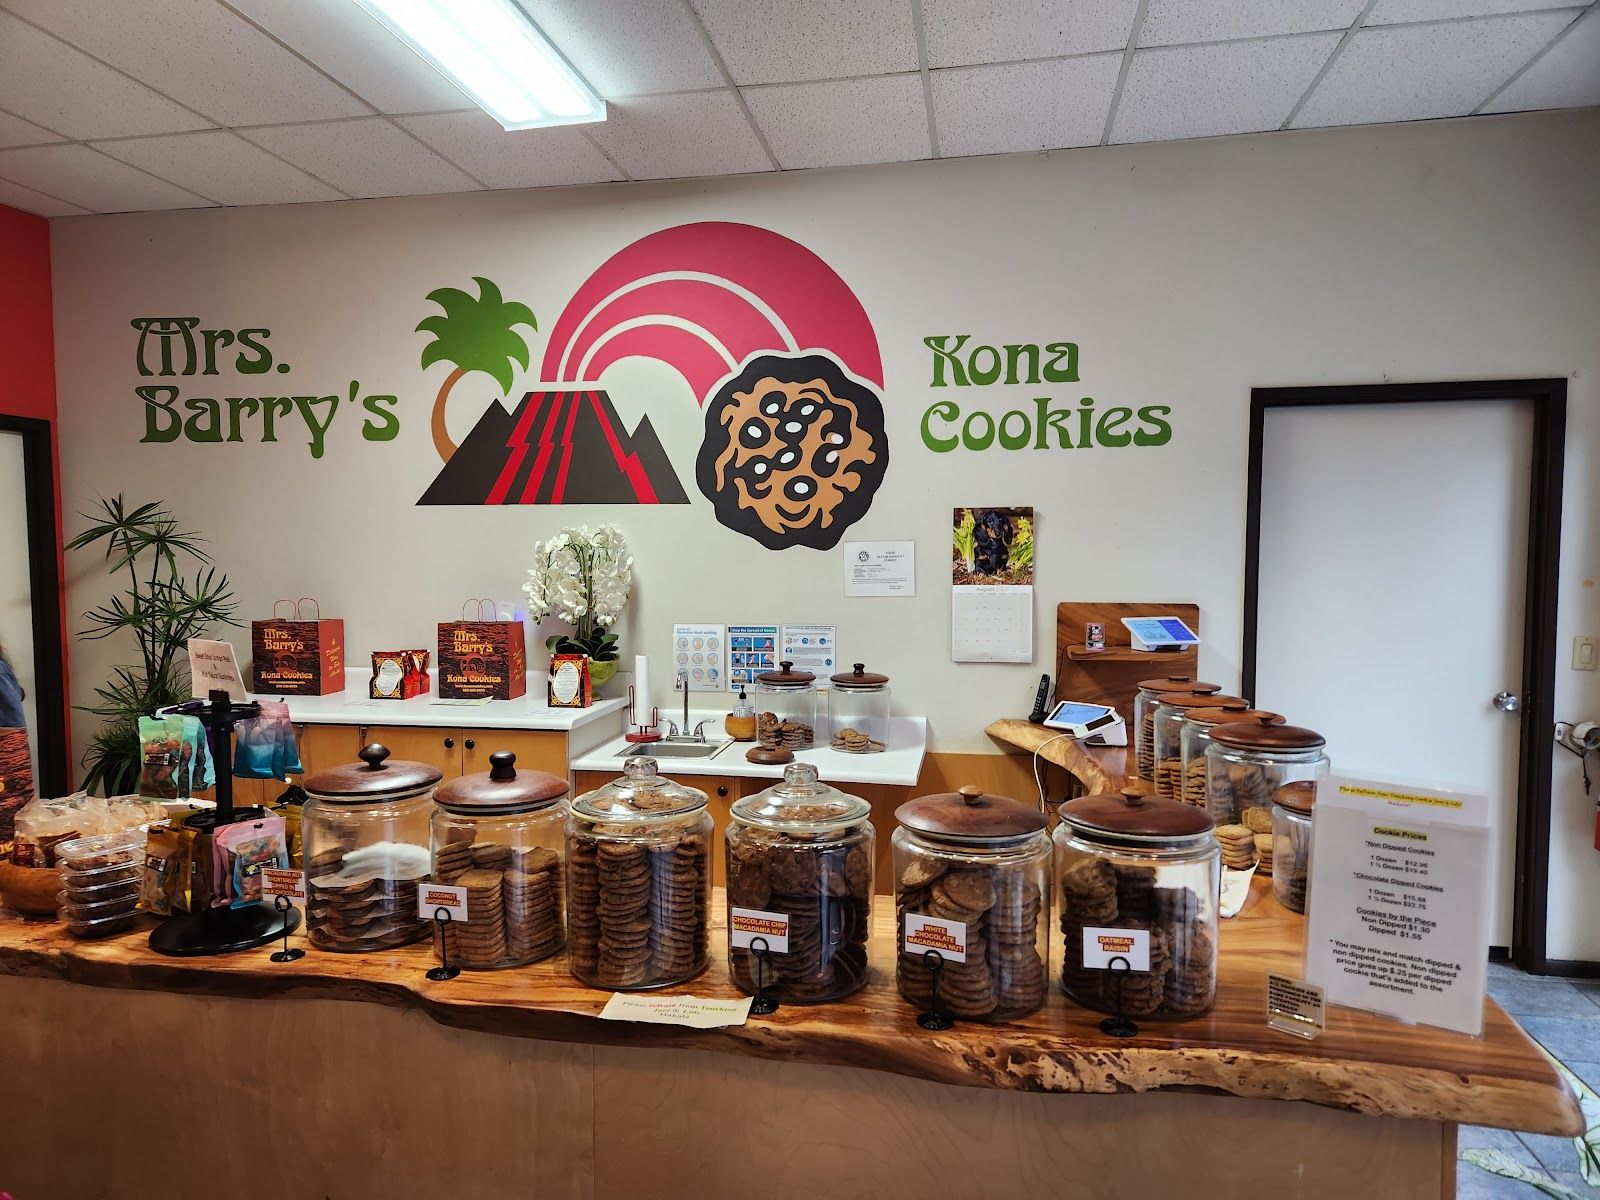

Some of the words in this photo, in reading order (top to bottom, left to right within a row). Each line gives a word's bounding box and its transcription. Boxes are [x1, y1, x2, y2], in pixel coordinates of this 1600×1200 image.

[130, 316, 291, 377] Mrs.
[923, 334, 1080, 388] Kona
[134, 379, 400, 459] Barry's
[920, 397, 1172, 453] Cookies
[264, 628, 291, 639] Mrs.
[454, 630, 480, 641] Mrs.
[264, 639, 304, 652] Barry's
[454, 641, 493, 655] Barry's
[261, 671, 281, 679] Kona
[282, 671, 313, 679] Cookies
[447, 675, 467, 683] Kona
[469, 675, 501, 683] Cookies
[1373, 826, 1400, 837] Cookie
[1401, 831, 1427, 841] Prices
[1383, 843, 1406, 852] Dipped
[1407, 847, 1435, 856] Cookies
[1376, 855, 1397, 863] Dozen
[1382, 863, 1403, 871] Dozen
[1390, 878, 1414, 888] Dipped
[1416, 882, 1444, 892] Cookies
[430, 891, 457, 899] COCONUT
[1374, 889, 1395, 897] Dozen
[1381, 897, 1402, 905] Dozen
[733, 916, 770, 927] CHOCOLATE
[1356, 906, 1387, 919] Cookies
[1388, 910, 1399, 920] by
[1400, 912, 1412, 923] the
[1414, 917, 1437, 928] Piece
[735, 923, 770, 933] MACADAMIA
[924, 924, 947, 934] WHITE
[1361, 916, 1377, 924] Non
[1378, 918, 1407, 930] Dipped
[1408, 924, 1431, 934] $1.30
[1368, 925, 1397, 936] Dipped
[915, 930, 955, 943] CHOCOLATE
[1099, 936, 1133, 945] OATMEAL
[908, 936, 948, 949] MACADAMIA
[948, 944, 963, 952] NUT
[1104, 944, 1129, 952] RAISIN
[1334, 940, 1348, 949] You
[1350, 944, 1366, 953] may
[1367, 946, 1381, 955] mix
[1382, 948, 1397, 958] and
[1398, 952, 1423, 963] match
[1424, 957, 1453, 970] dipped
[1454, 963, 1461, 971] &
[1332, 949, 1347, 957] non
[1348, 950, 1375, 962] dipped
[1377, 957, 1409, 969] cookies.
[1410, 963, 1427, 973] Non
[1428, 967, 1457, 979] dipped
[1336, 958, 1356, 967] price
[1357, 961, 1376, 971] goes
[1378, 965, 1388, 974] up
[1408, 972, 1422, 981] per
[1423, 974, 1452, 986] dipped
[1343, 966, 1369, 977] cookie
[1370, 971, 1392, 982] that's
[1393, 976, 1418, 987] added
[1420, 981, 1428, 990] to
[1429, 982, 1443, 993] the
[1368, 981, 1416, 995] assortment.
